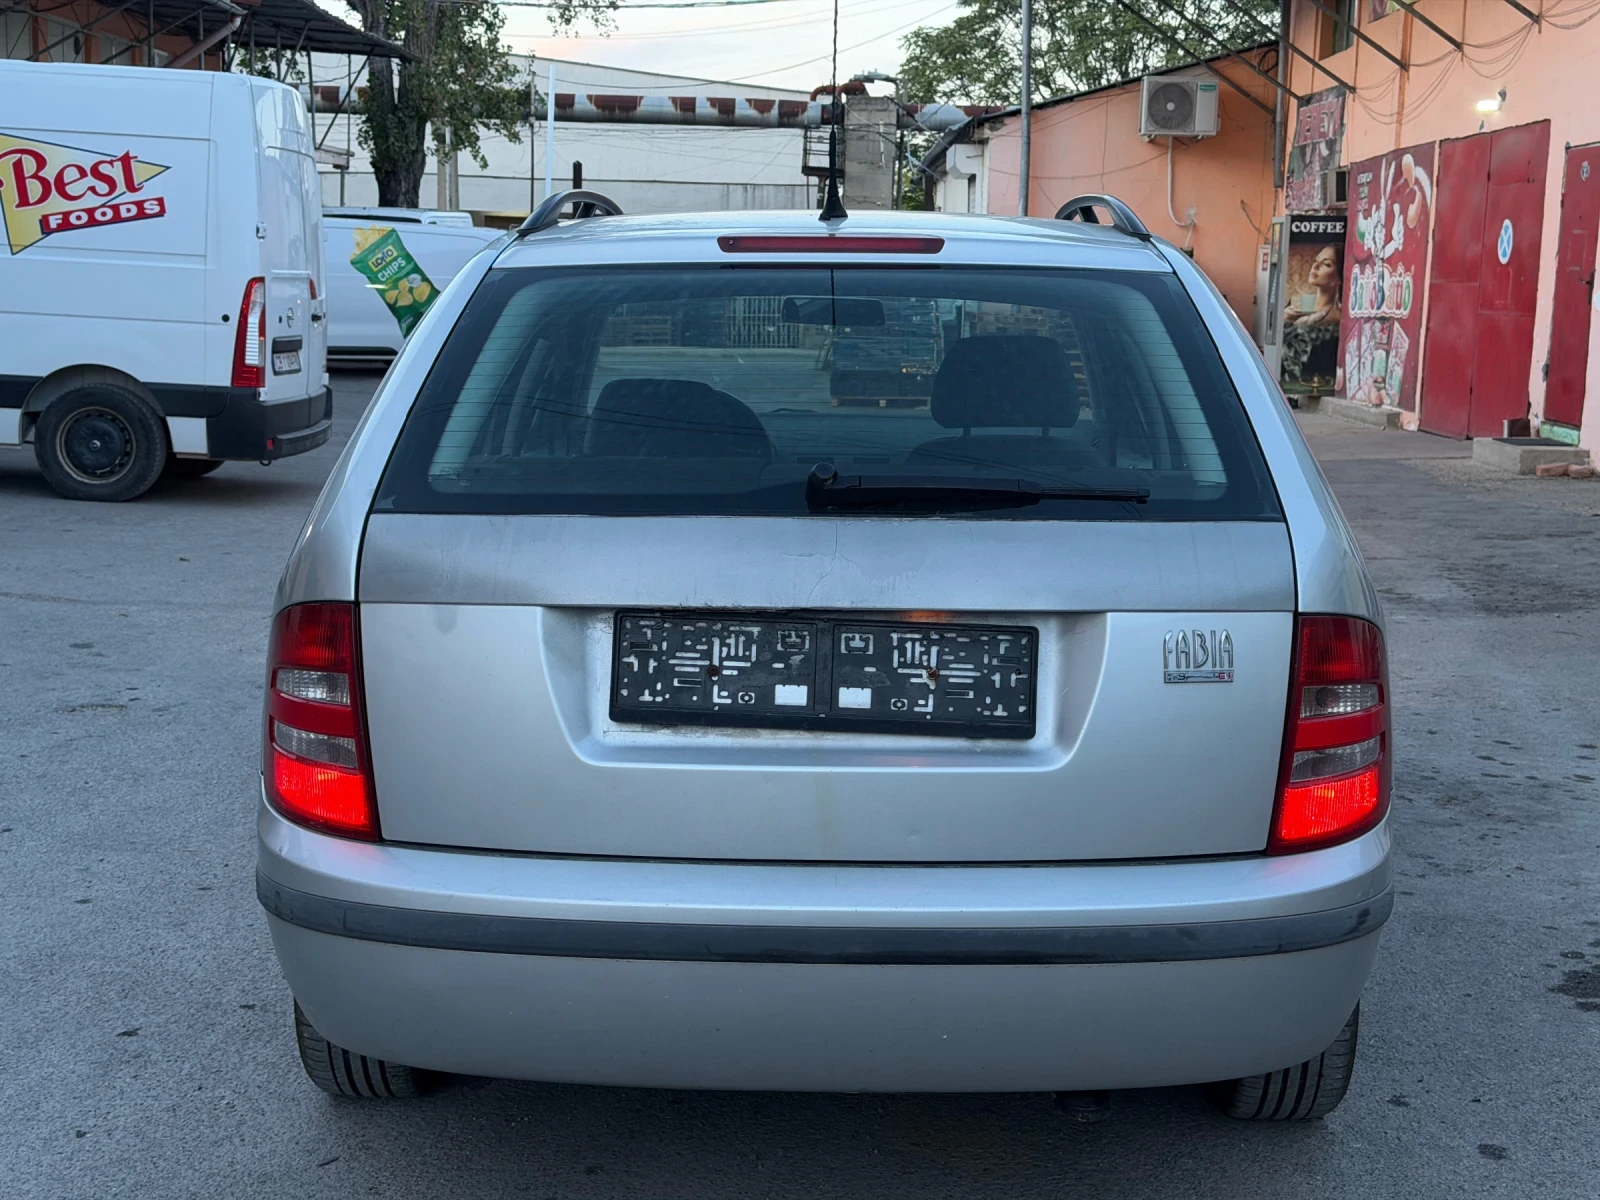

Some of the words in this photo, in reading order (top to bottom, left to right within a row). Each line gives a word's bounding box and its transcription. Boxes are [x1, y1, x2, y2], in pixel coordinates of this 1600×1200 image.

[0, 148, 145, 209] Best
[48, 199, 161, 229] FOODS
[1291, 221, 1345, 233] COFFEE
[377, 257, 406, 282] CHIPS
[1163, 629, 1234, 669] FABIA
